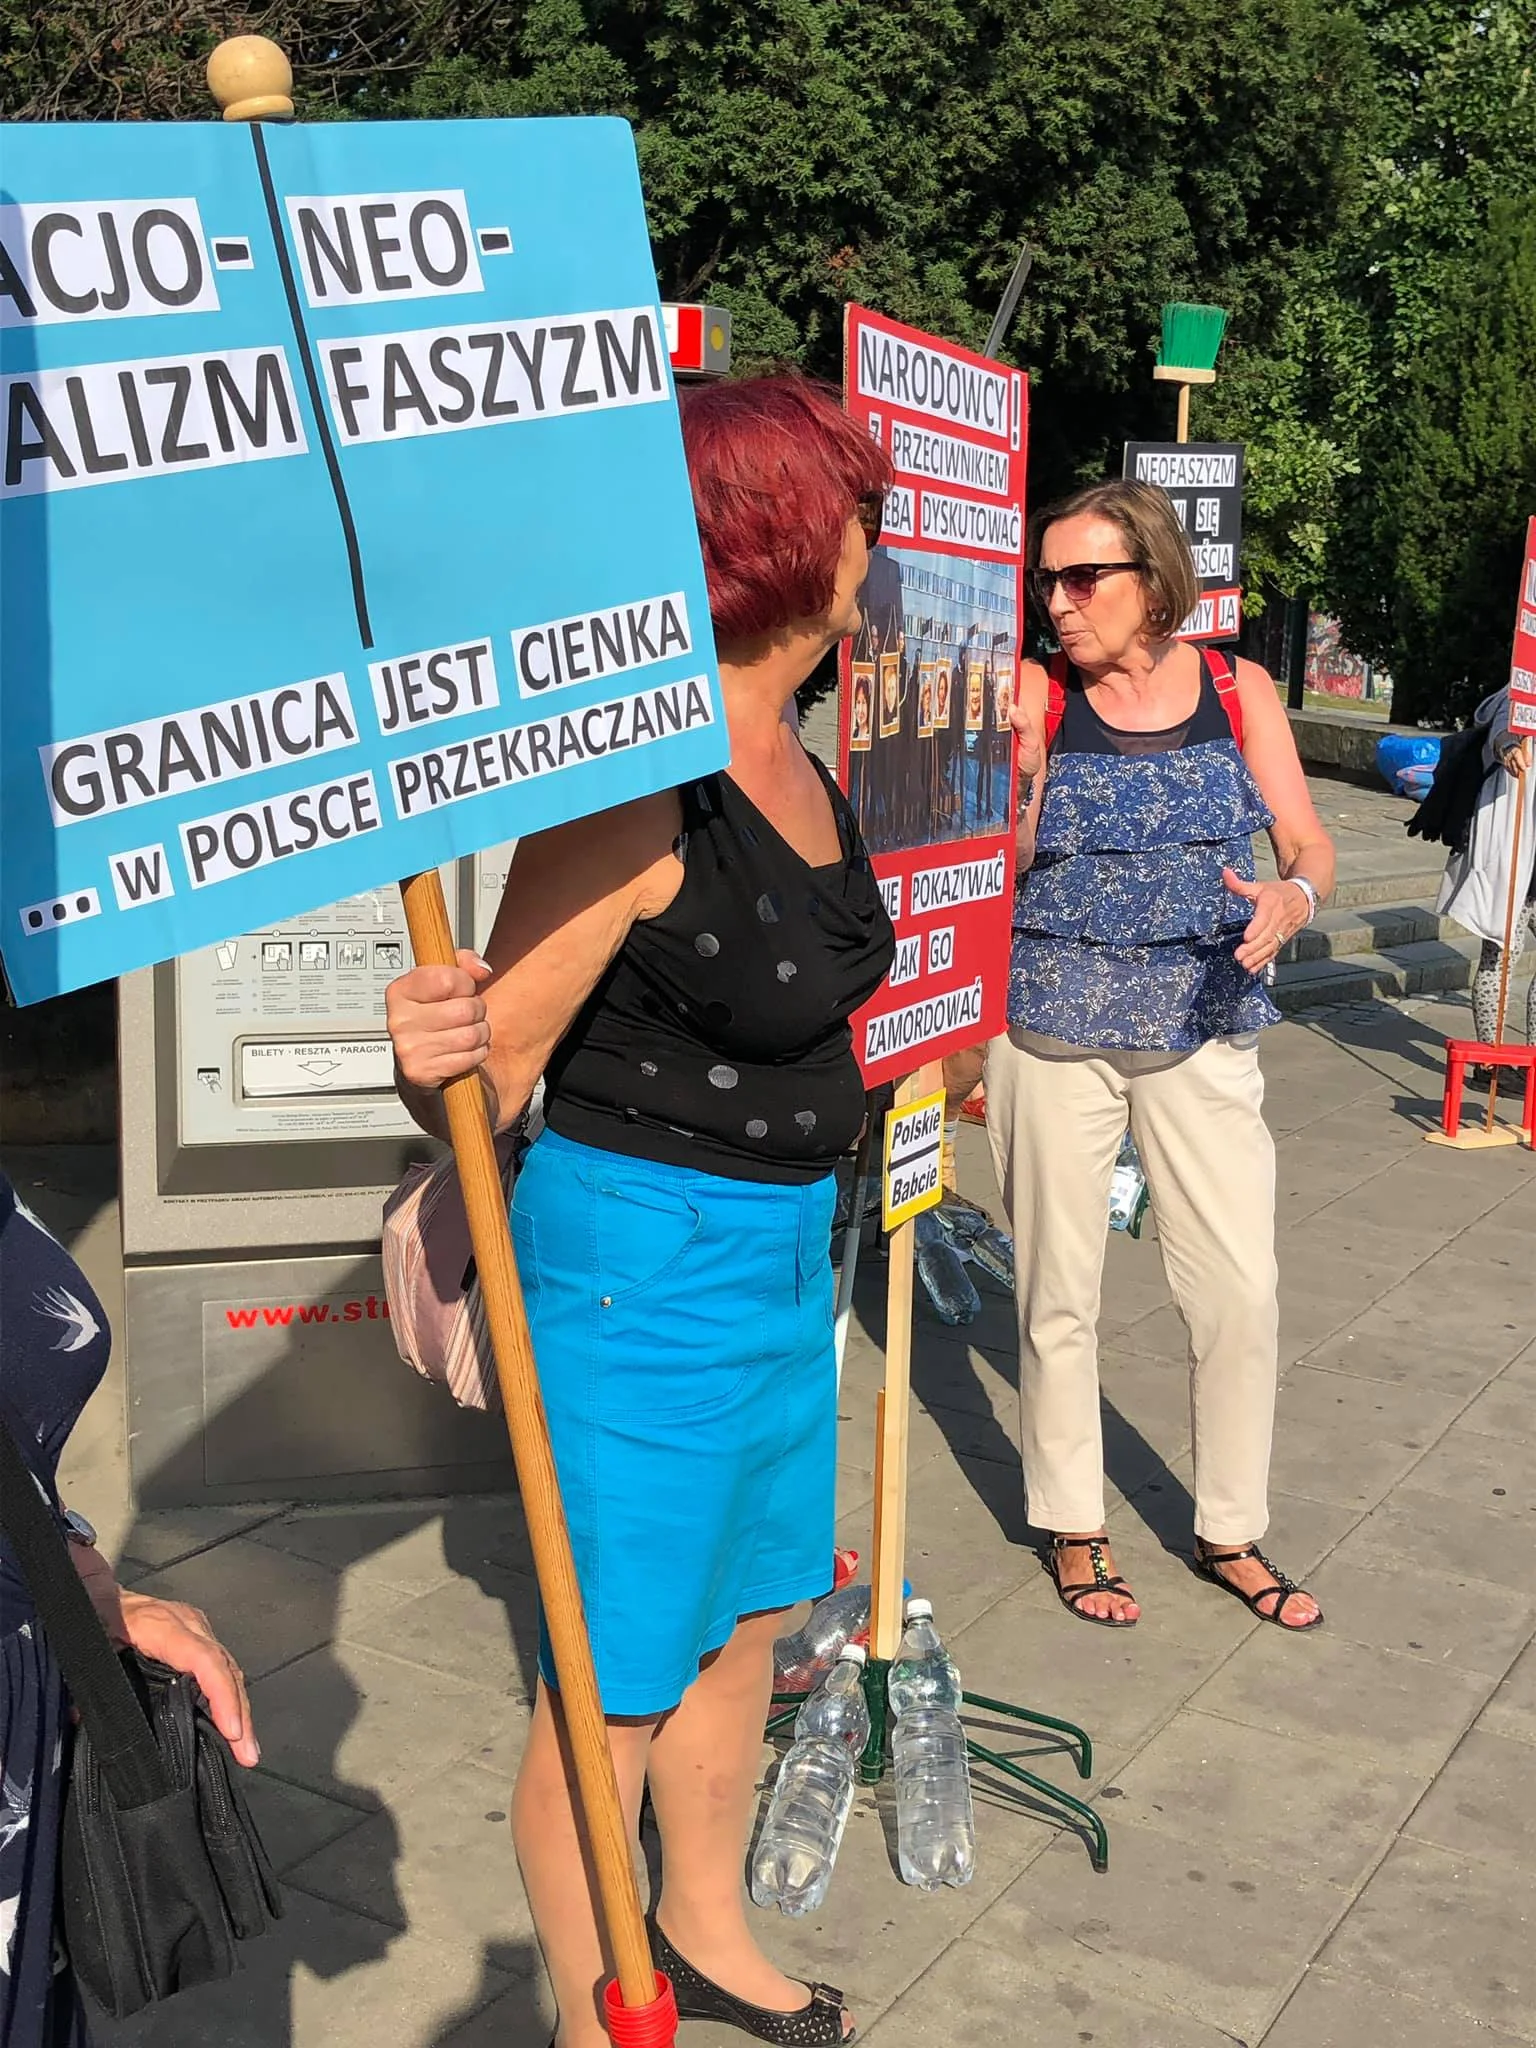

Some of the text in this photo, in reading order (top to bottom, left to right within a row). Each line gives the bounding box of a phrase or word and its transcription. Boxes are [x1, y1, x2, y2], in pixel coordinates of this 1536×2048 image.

[298, 199, 509, 297] NEO-
[329, 315, 661, 436] FASZYZM
[4, 353, 297, 485] ALIZM
[894, 427, 1008, 490] PRZECIWNIKIEM
[1138, 456, 1234, 485] NEOFASZYZM
[923, 496, 1019, 548] DYSKUTOWAĆ
[1198, 501, 1218, 535] SIĘ
[1180, 598, 1235, 632] MY JĄ
[52, 600, 688, 816] GRANICA JEST CIENKA
[187, 777, 377, 882] POLSCE
[396, 681, 710, 813] PRZEKRACZANA
[912, 852, 1002, 911] POKAZYWAĆ
[891, 932, 951, 982] JAK GO
[867, 978, 980, 1058] ZAMORDOWAĆ
[251, 1045, 387, 1057] BILETY RESZTA PARAGON
[892, 1107, 940, 1150] Polskie
[892, 1163, 937, 1208] Babcie
